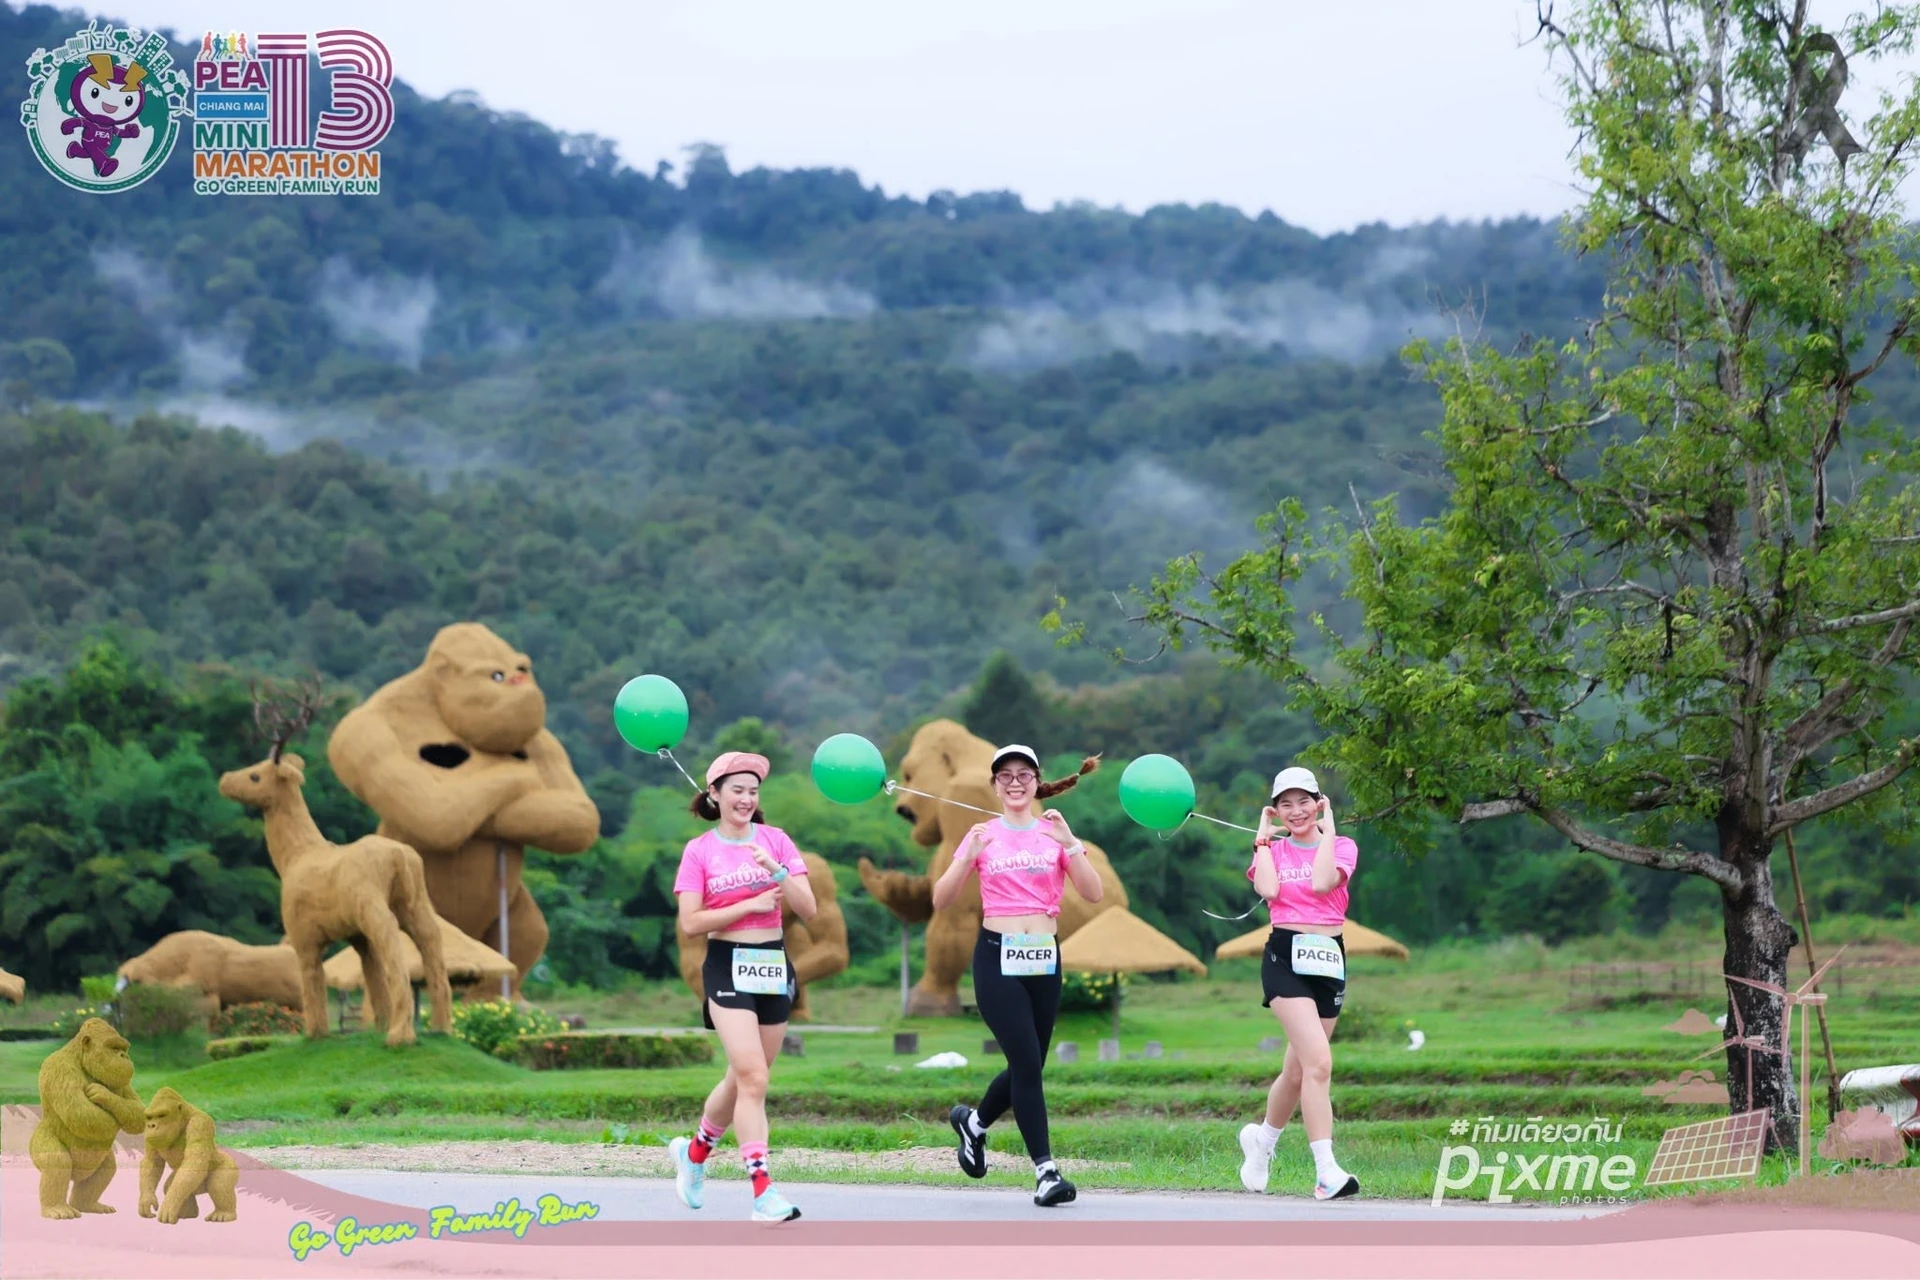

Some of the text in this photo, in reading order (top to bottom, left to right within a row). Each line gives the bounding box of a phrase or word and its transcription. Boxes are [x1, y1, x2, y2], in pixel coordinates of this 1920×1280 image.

[1006, 949, 1052, 960] PACER
[1297, 948, 1340, 965] PACER
[738, 965, 782, 978] PACER
